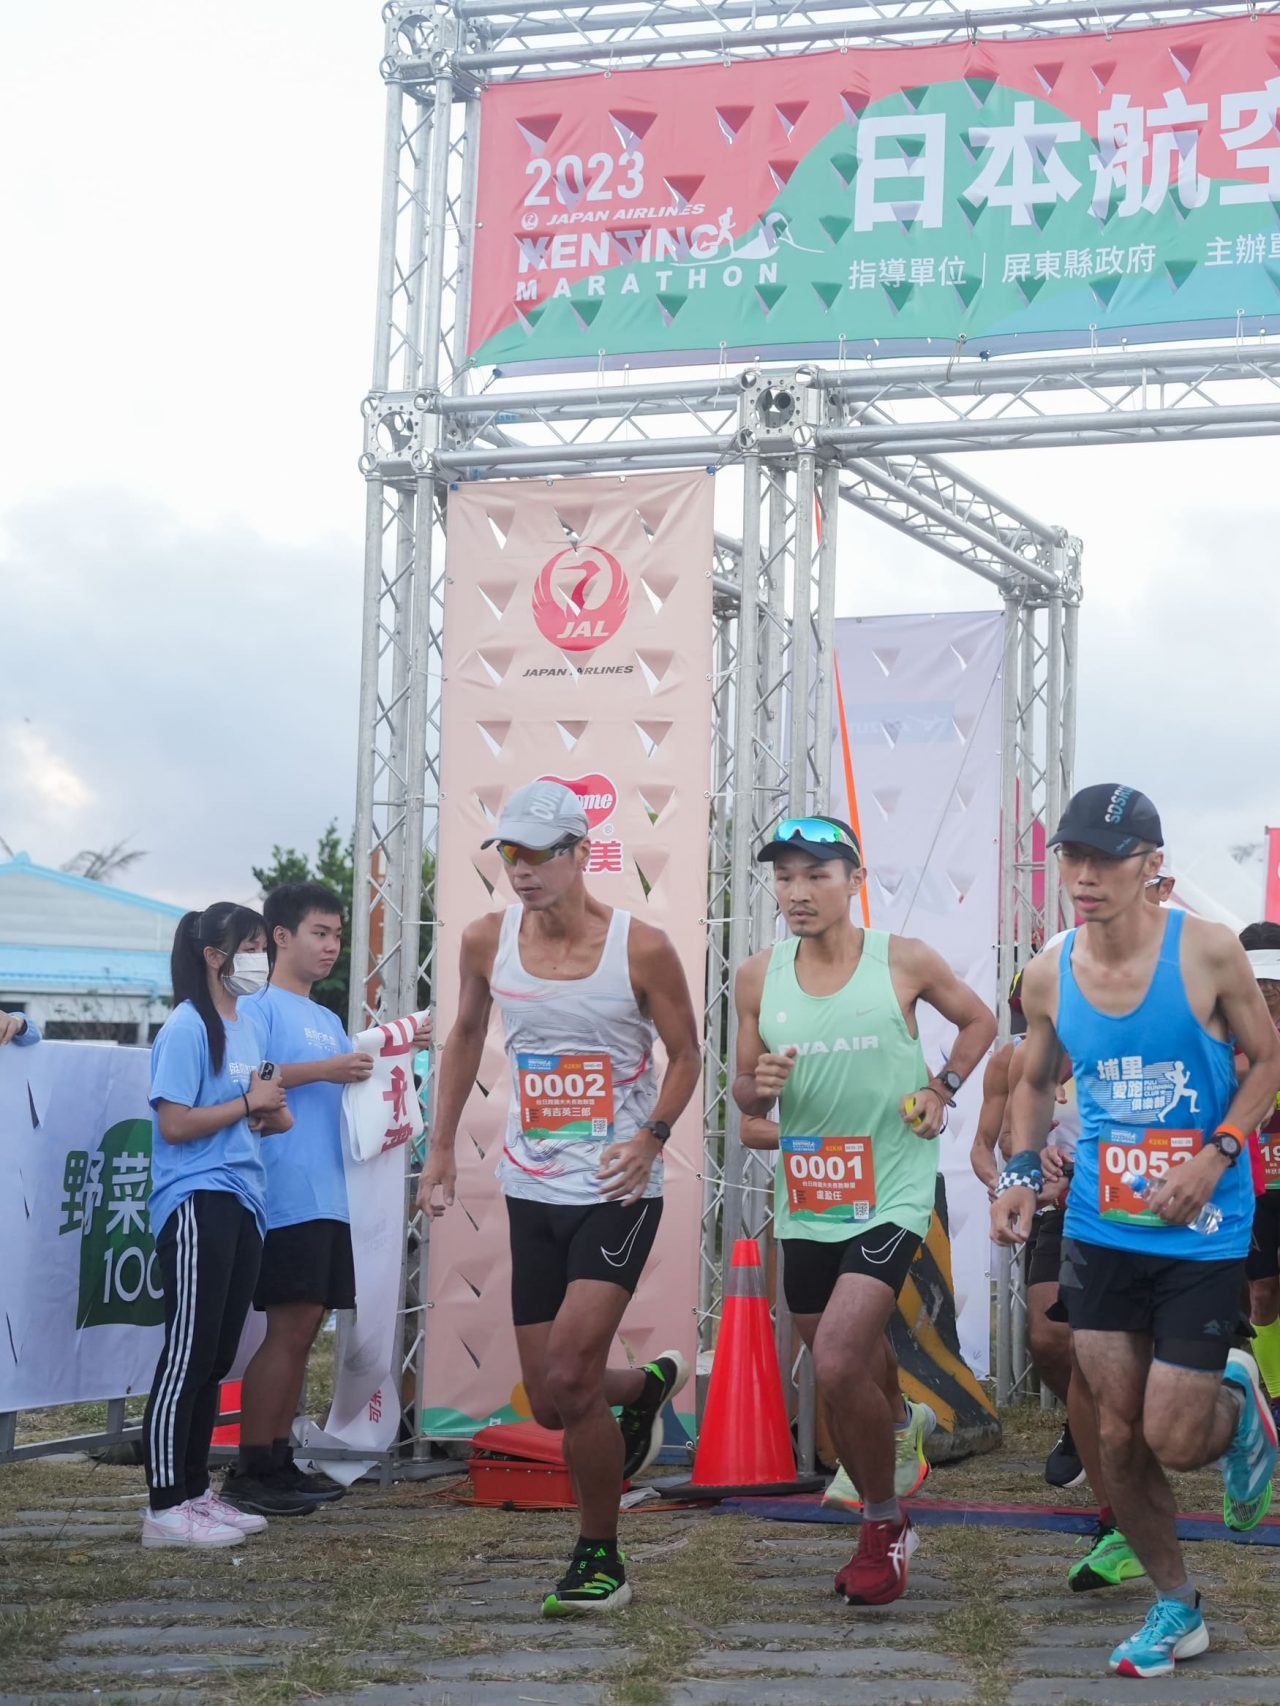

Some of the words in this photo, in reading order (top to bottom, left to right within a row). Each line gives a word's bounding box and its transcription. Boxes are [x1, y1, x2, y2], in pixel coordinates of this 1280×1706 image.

[524, 152, 644, 206] 2023
[546, 211, 603, 226] JAPAN
[613, 203, 706, 221] AIRLINES
[518, 223, 720, 273] KENTING
[848, 255, 967, 289] 指導單位
[1001, 242, 1157, 284] 屏東縣政府
[516, 262, 779, 301] MARATHON
[556, 620, 610, 639] JAL
[522, 668, 568, 678] JAPAN
[570, 665, 634, 677] ARLINES
[833, 1036, 880, 1052] AIR
[525, 1073, 606, 1097] 0002
[790, 1155, 863, 1180] 0001
[58, 1150, 154, 1236] 野菜
